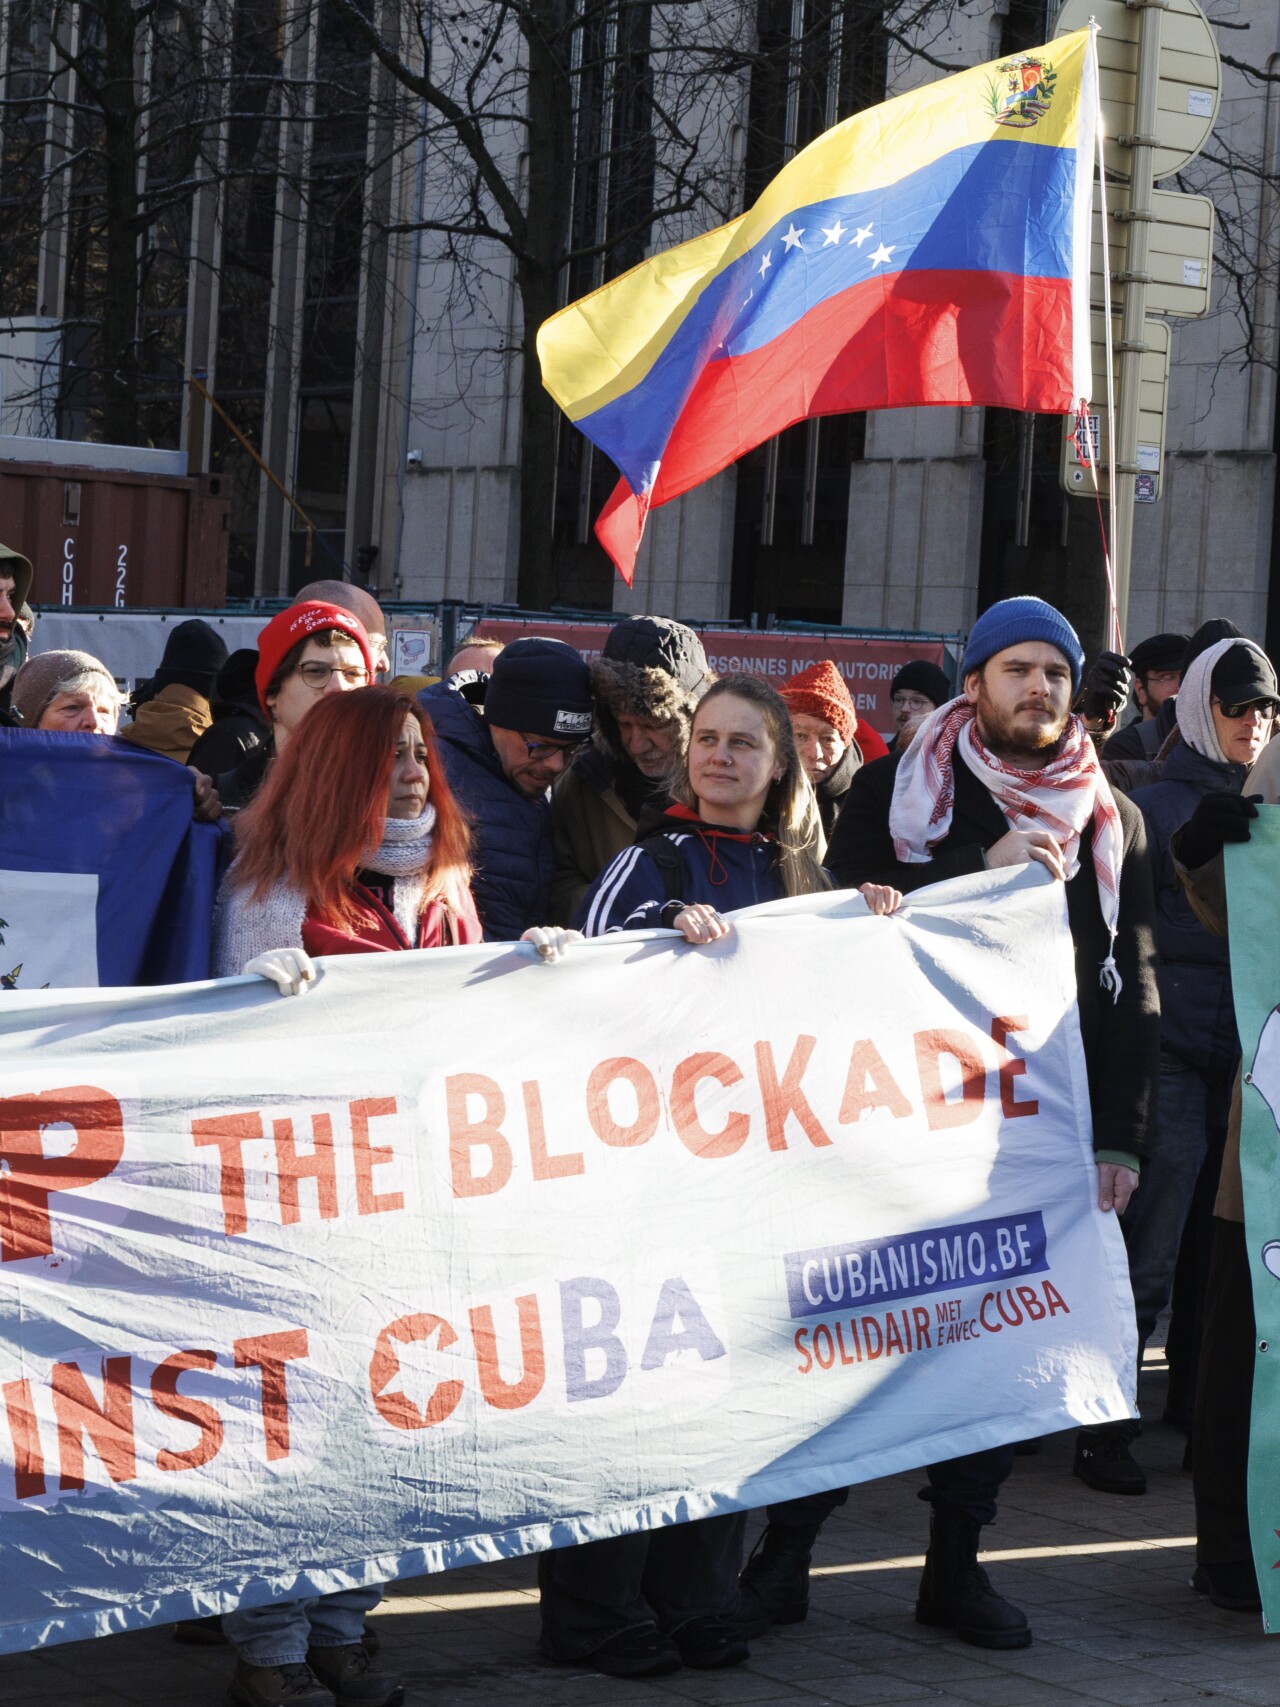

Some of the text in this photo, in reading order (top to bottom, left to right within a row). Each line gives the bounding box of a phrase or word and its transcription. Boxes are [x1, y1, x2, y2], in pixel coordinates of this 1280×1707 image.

[837, 660, 911, 679] AUTORIS
[191, 1096, 405, 1236] THE
[444, 1014, 1039, 1199] BLOCKADE
[802, 1224, 1032, 1306] CUBANISMO.BE
[935, 1299, 962, 1324] MET
[946, 1318, 981, 1344] AVEC
[979, 1279, 1071, 1333] CUBA
[794, 1306, 932, 1374] SOLIDAIR
[2, 1275, 726, 1500] INST CUBA
